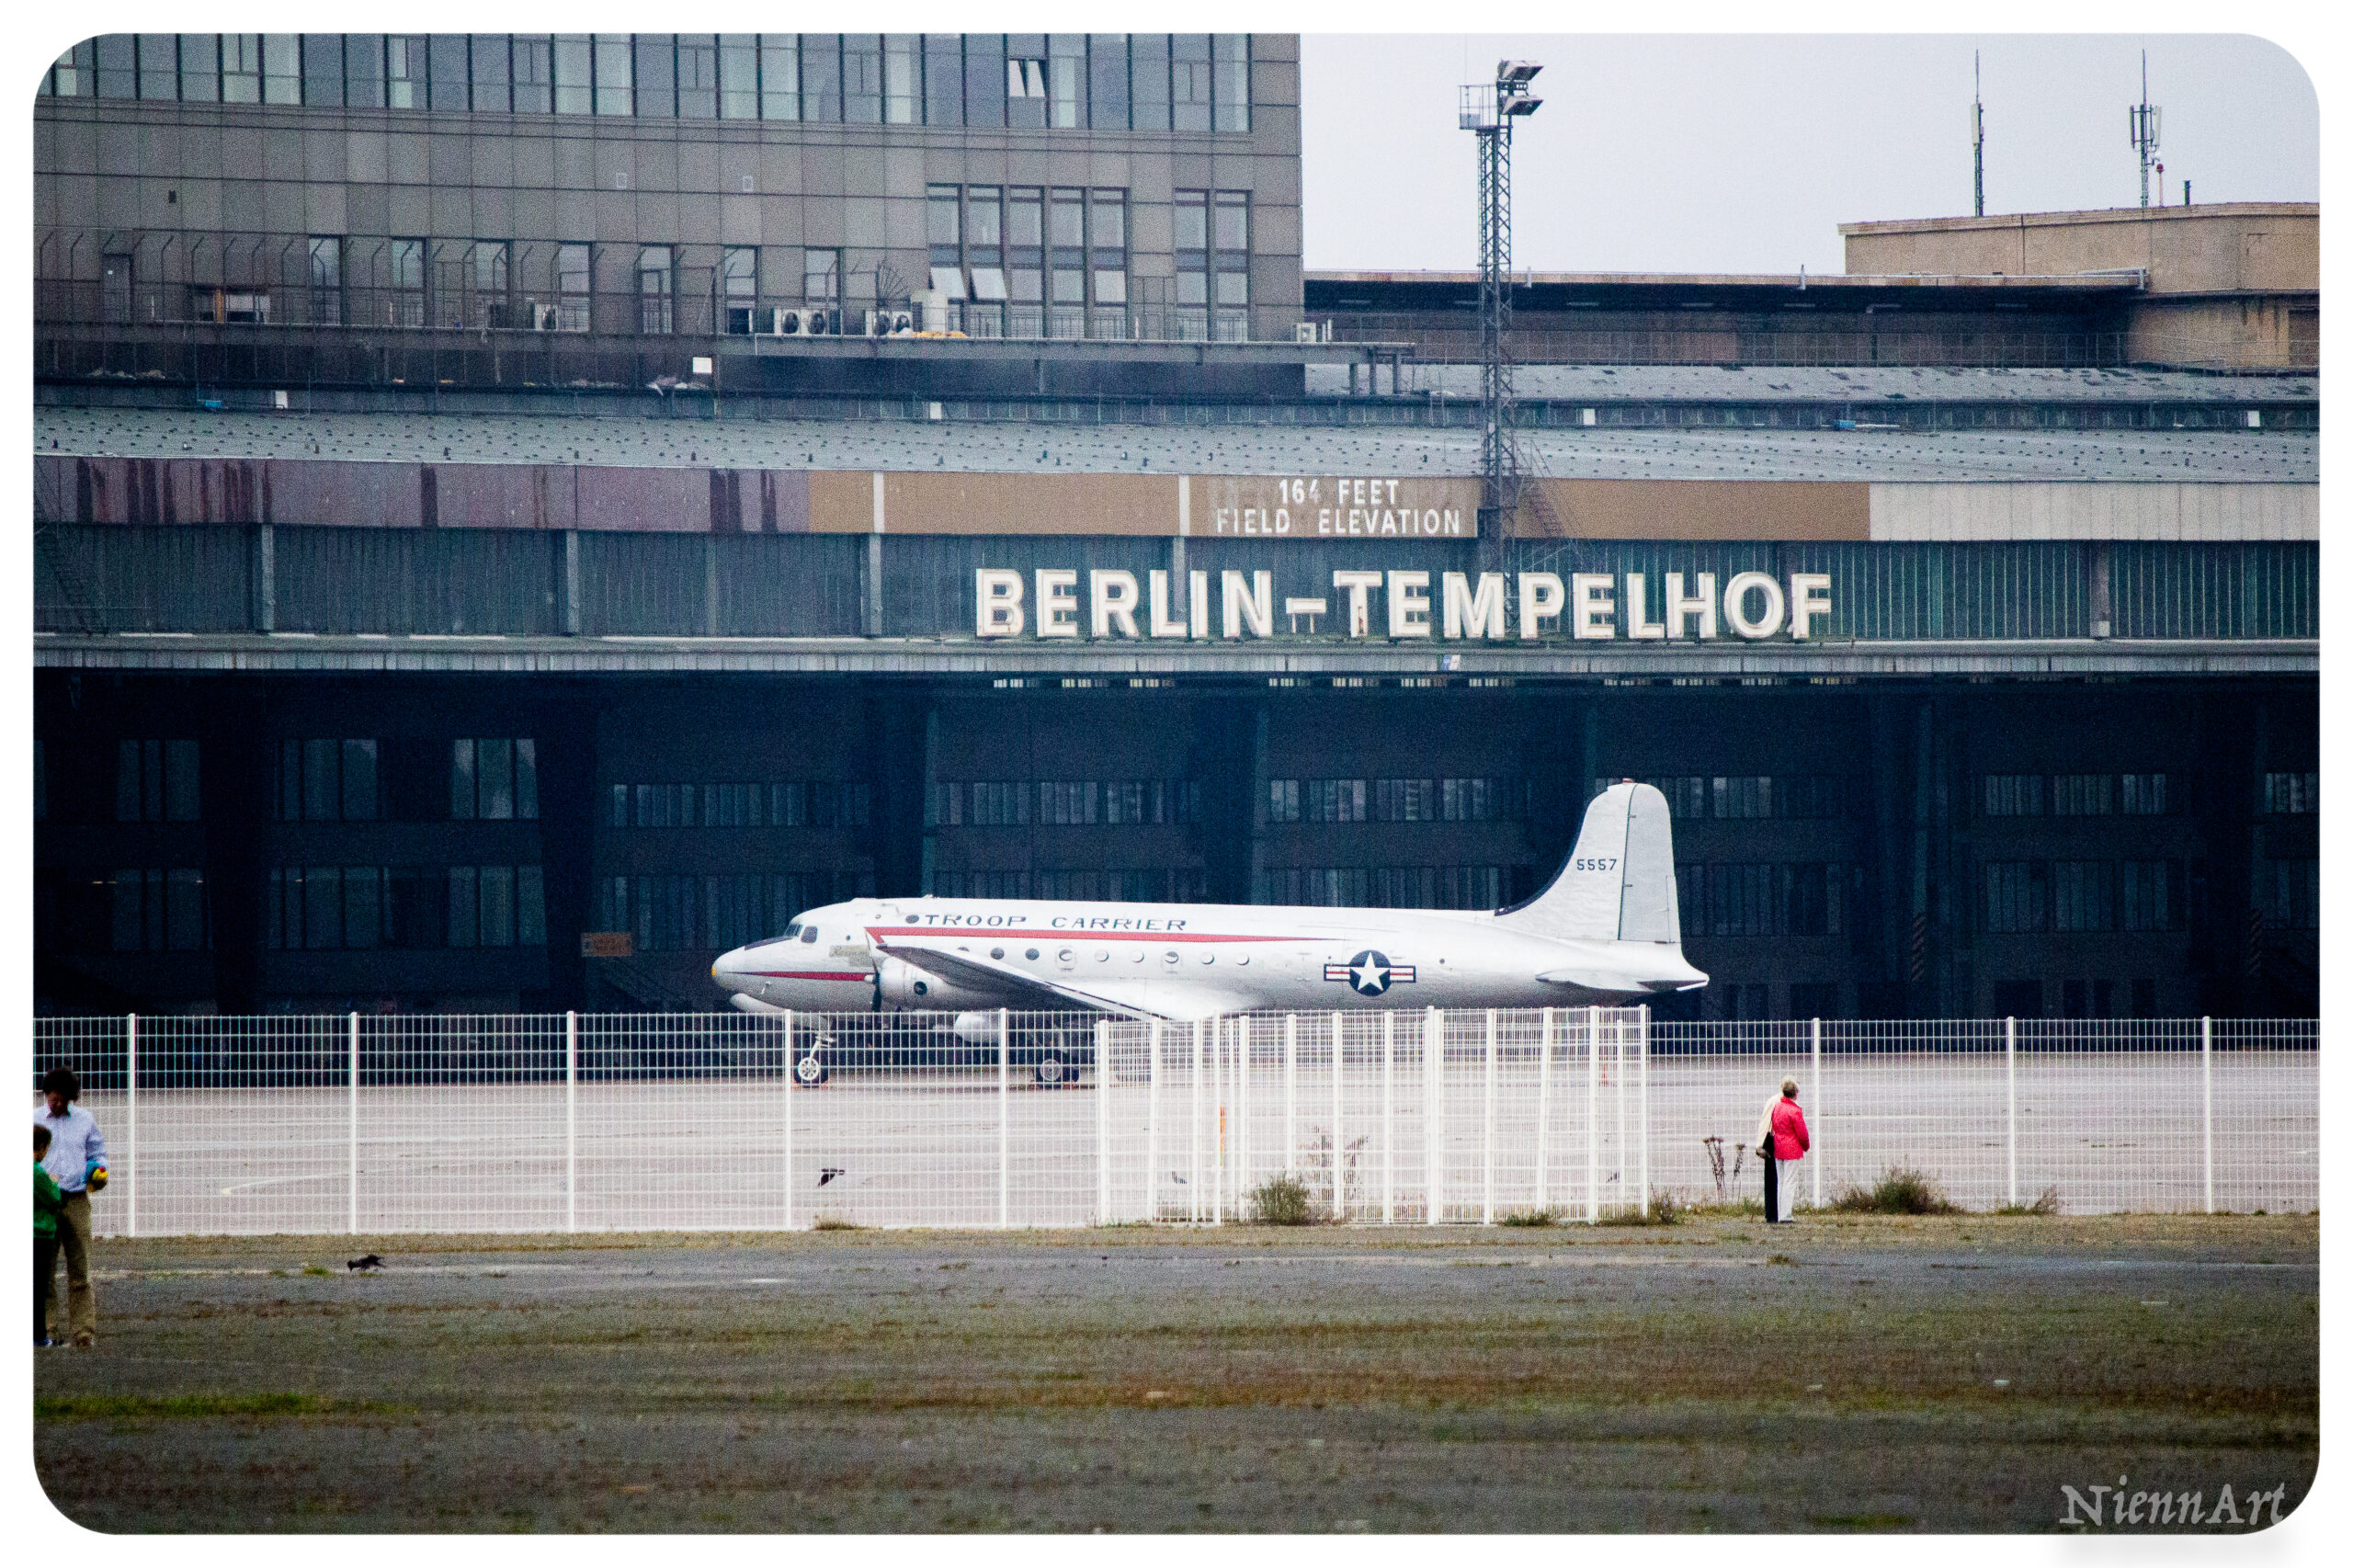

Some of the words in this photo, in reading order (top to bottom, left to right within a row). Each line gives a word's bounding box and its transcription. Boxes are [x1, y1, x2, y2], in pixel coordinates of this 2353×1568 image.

[1279, 479, 1321, 505] 164
[1338, 480, 1399, 506] FEET
[1216, 508, 1290, 534] FIELD
[1318, 508, 1461, 535] ELEVATION
[975, 568, 1832, 641] BERLIN-TEMPELHOF
[1576, 858, 1617, 870] 5557
[926, 914, 1027, 927] TROOP
[1051, 916, 1187, 931] CARRIER
